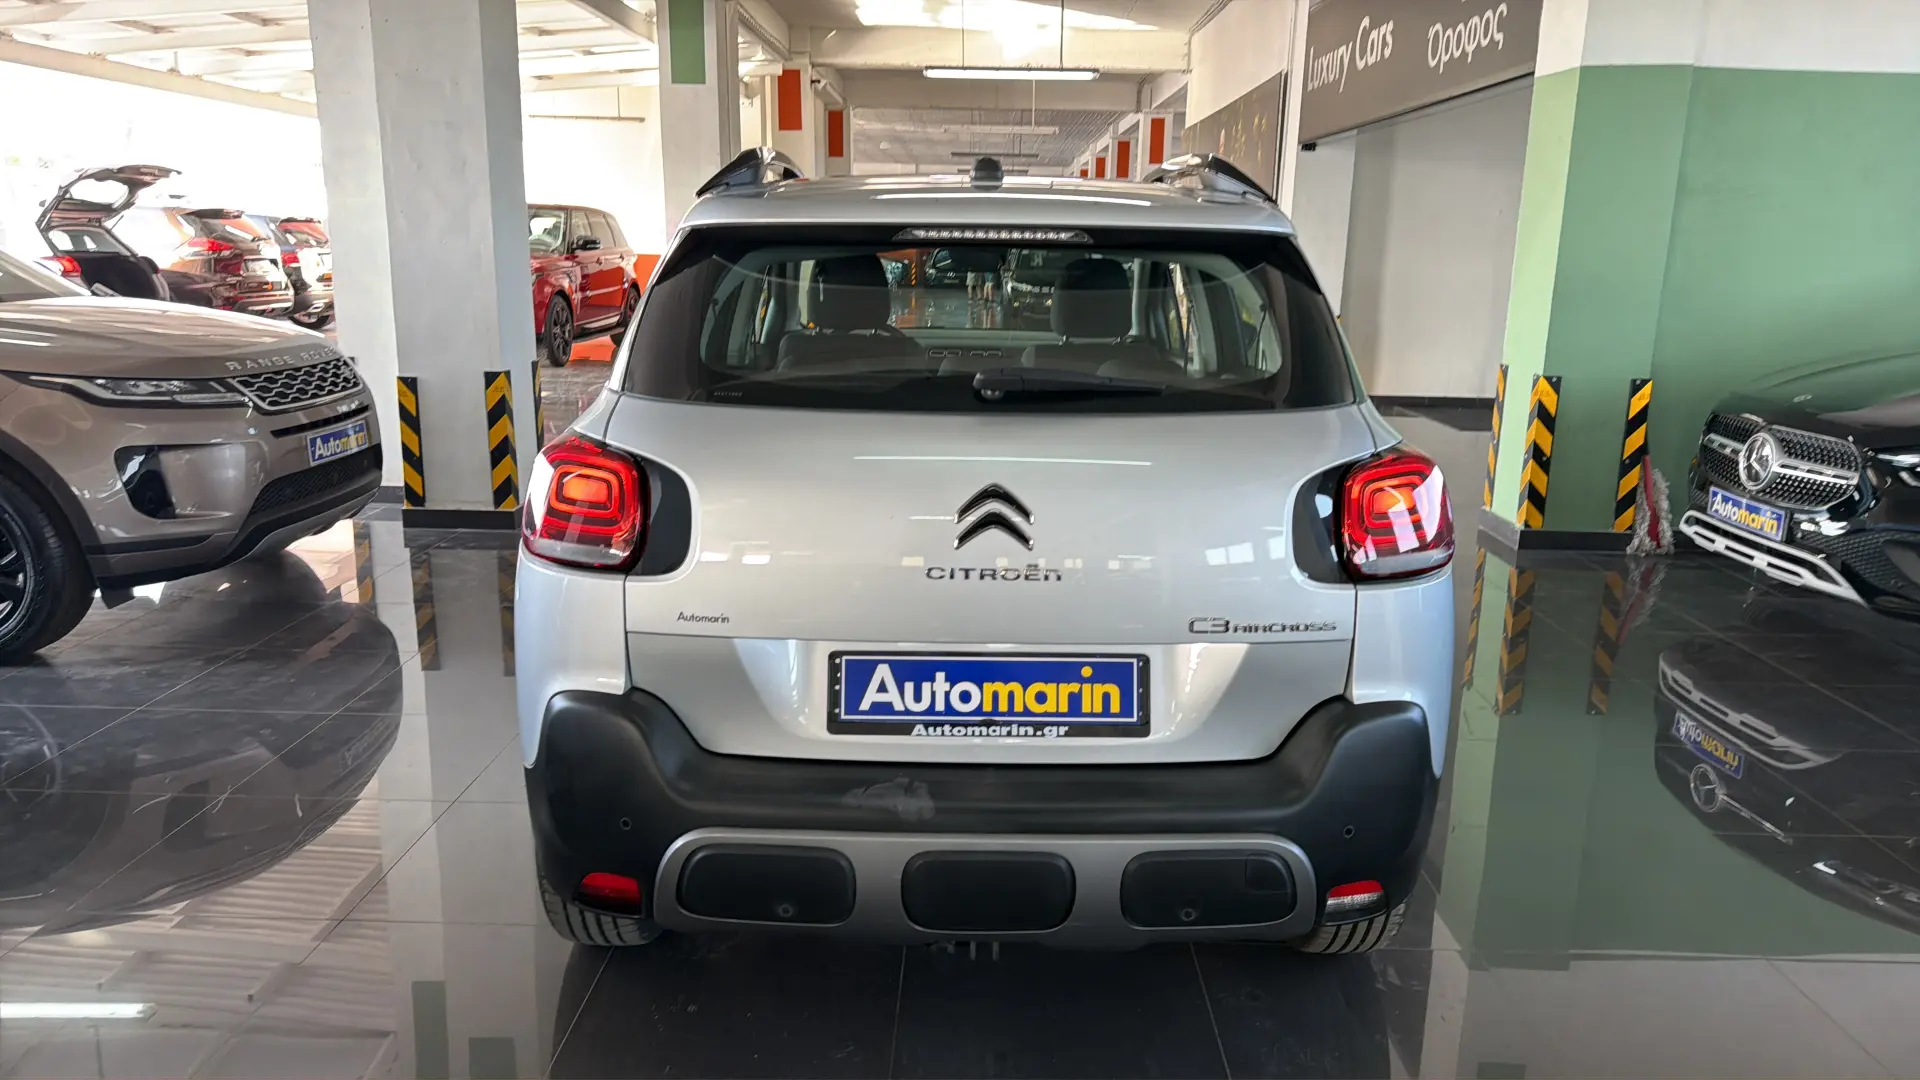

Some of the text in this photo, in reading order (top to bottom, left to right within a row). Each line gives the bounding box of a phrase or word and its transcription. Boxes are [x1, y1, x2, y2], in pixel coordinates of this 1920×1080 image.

[1306, 15, 1393, 94] Luxury Cars
[225, 355, 295, 371] RANGE
[1711, 492, 1777, 534] Automarin
[925, 564, 1062, 581] CITROËN
[677, 611, 730, 623] Automarin
[1189, 617, 1337, 634] C3 AIRCROSS
[858, 663, 1121, 713] Automarin
[911, 723, 1069, 738] Automarin.gr
